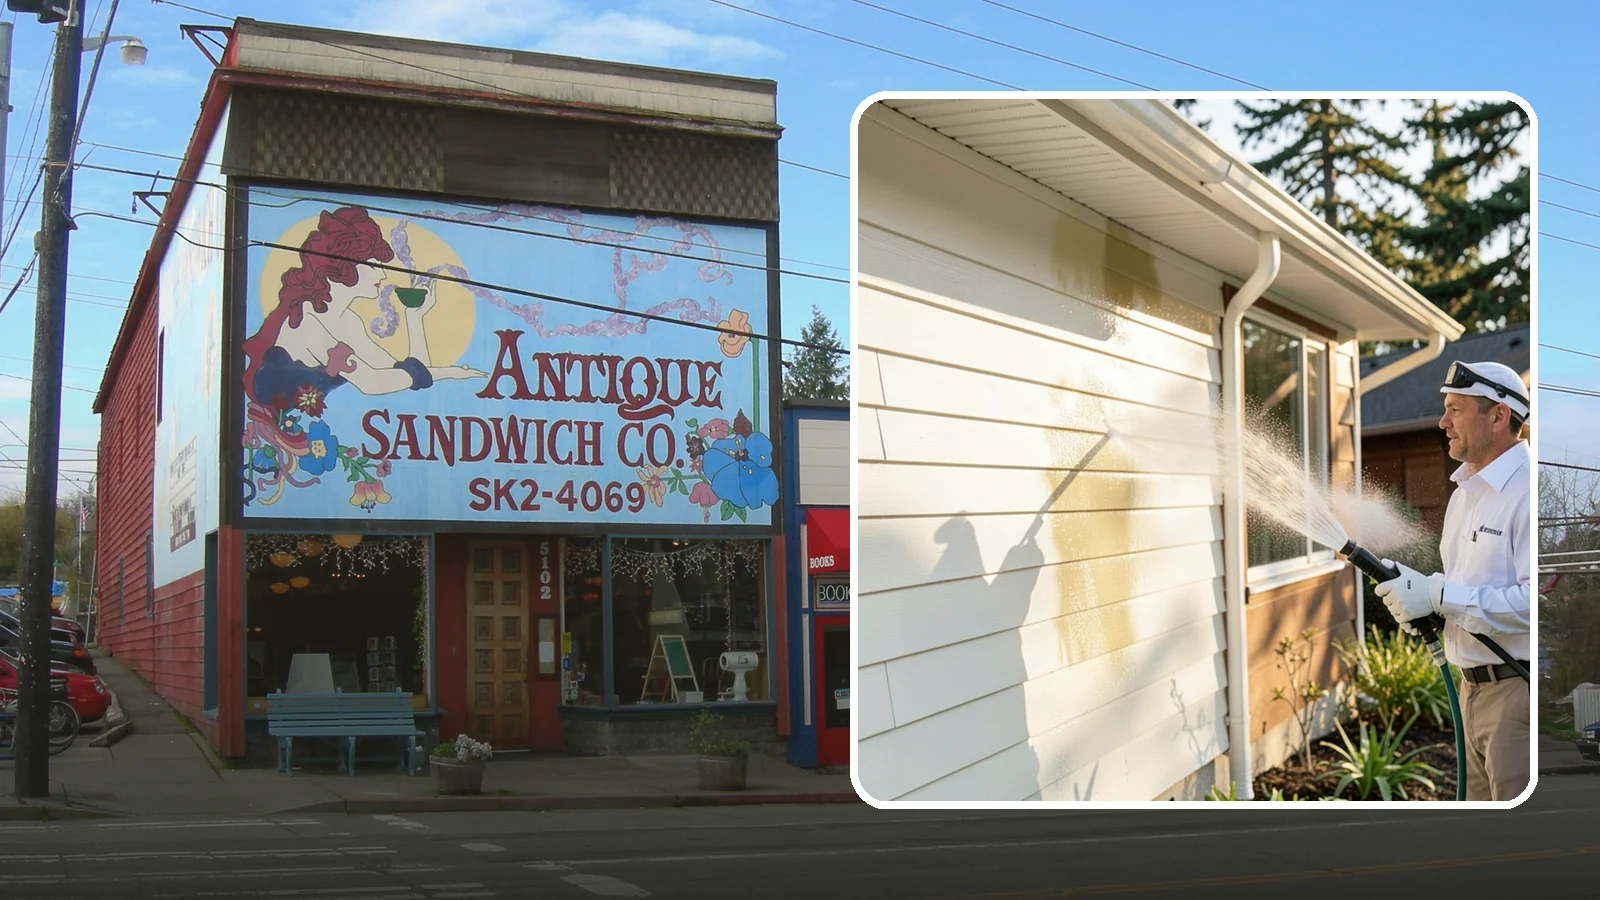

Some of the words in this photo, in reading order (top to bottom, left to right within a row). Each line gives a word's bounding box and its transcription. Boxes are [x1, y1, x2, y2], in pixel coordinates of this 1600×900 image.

[475, 330, 723, 420] ANTIQUE
[361, 409, 604, 467] SANDWICH
[617, 422, 684, 469] CO.
[468, 478, 645, 512] SK2-4069
[539, 542, 552, 600] 5102
[809, 555, 835, 569] BOOKS
